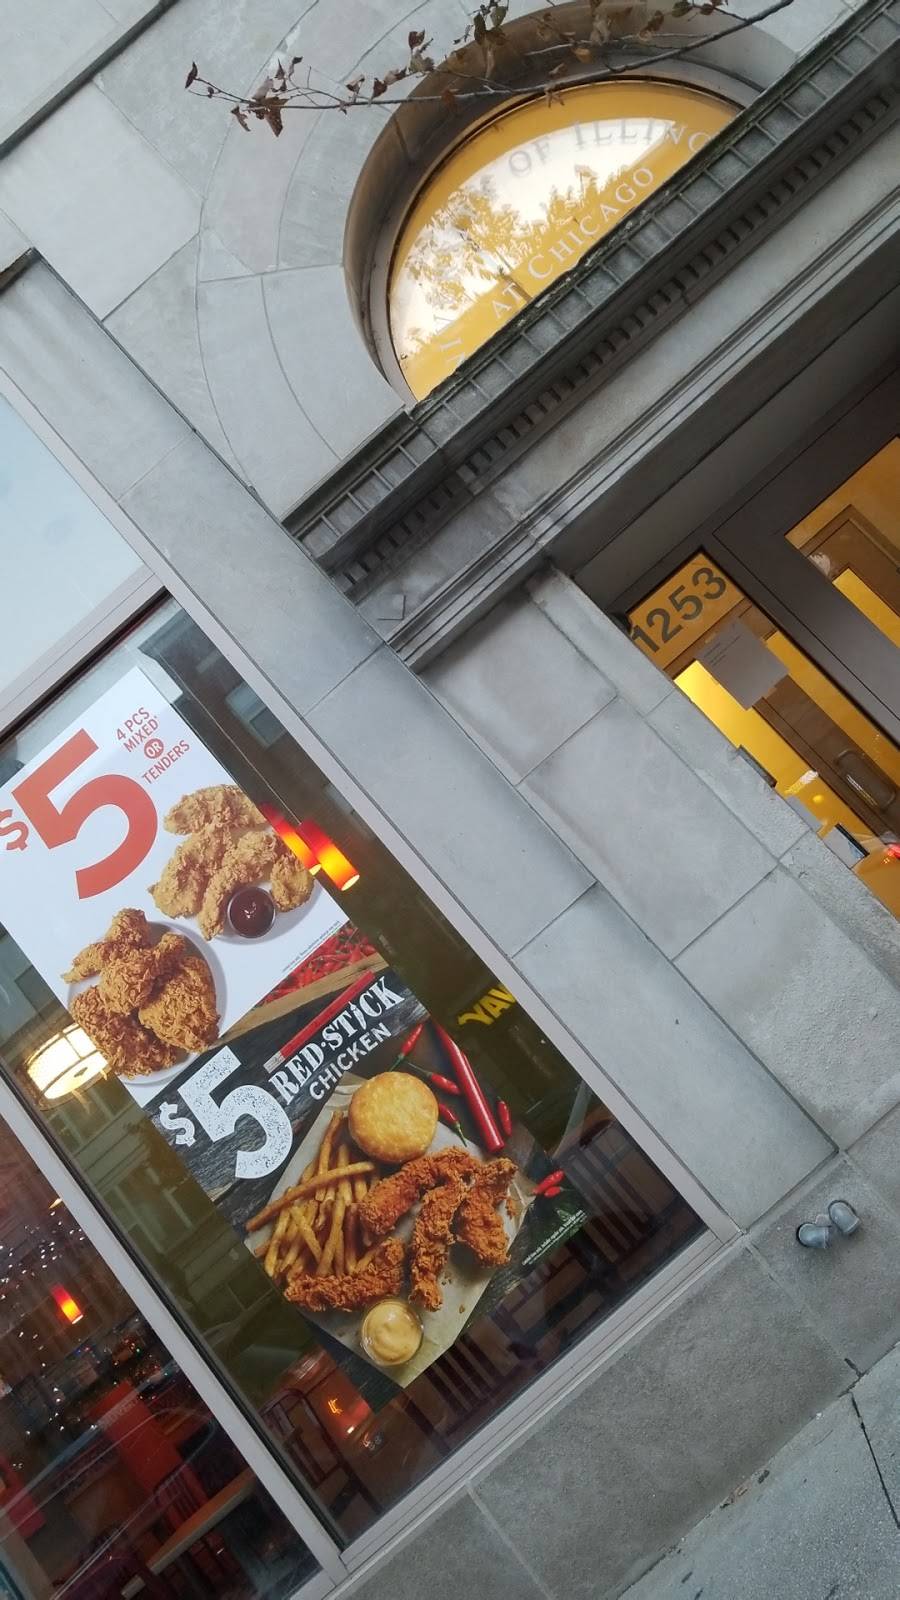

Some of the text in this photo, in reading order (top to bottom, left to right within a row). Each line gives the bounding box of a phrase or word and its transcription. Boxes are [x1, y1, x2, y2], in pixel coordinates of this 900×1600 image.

[508, 135, 550, 174] OF
[491, 167, 654, 319] AT CHICAGO
[632, 567, 727, 655] 1253
[116, 707, 151, 741] 4 PCS
[146, 741, 163, 758] OR
[141, 740, 191, 785] TENDERS
[308, 1021, 393, 1101] CHICKEN
[159, 1045, 294, 1180] $5
